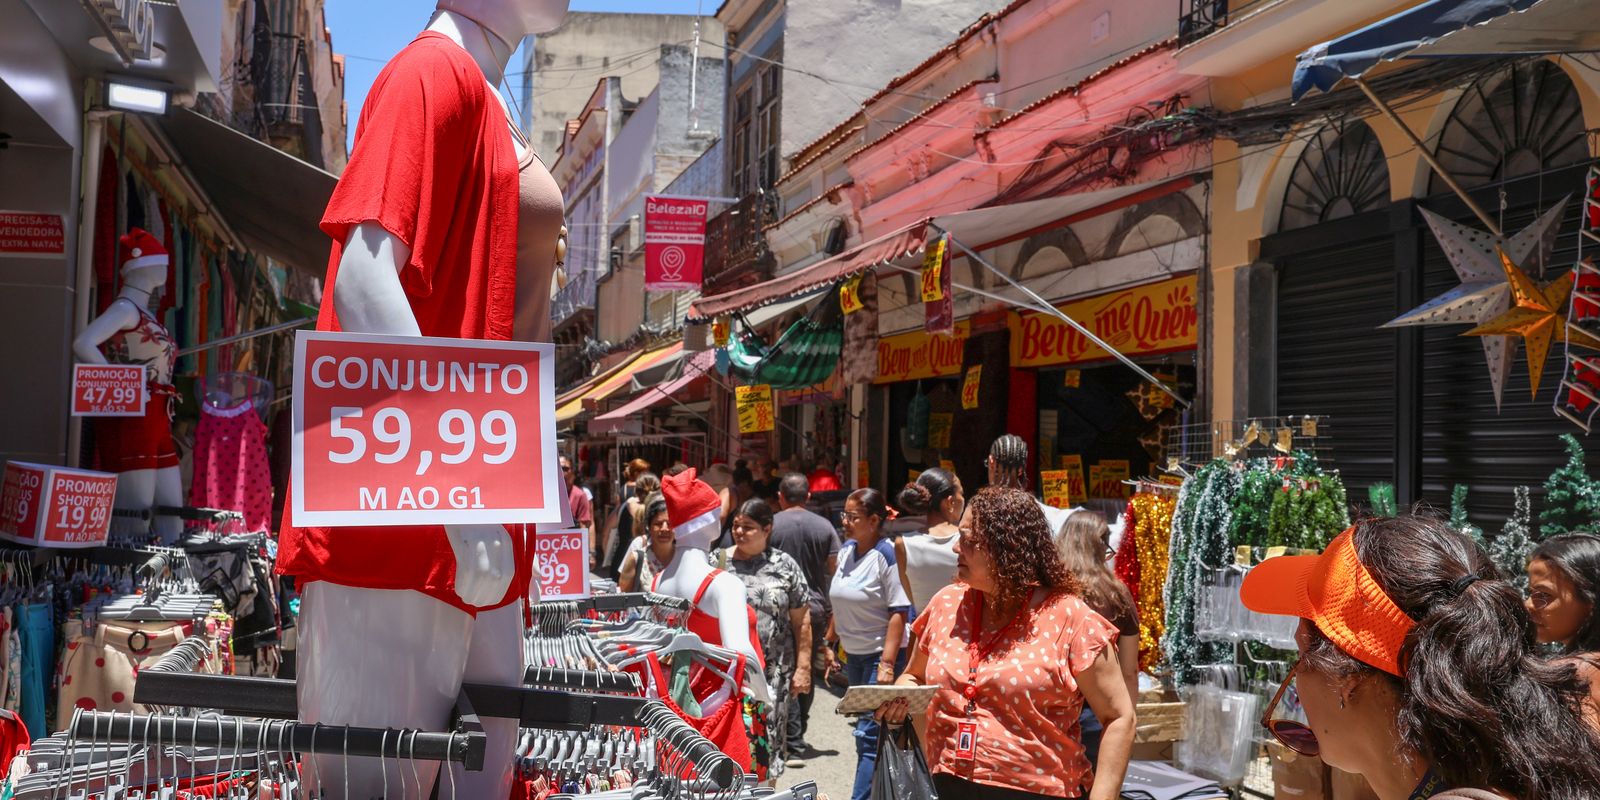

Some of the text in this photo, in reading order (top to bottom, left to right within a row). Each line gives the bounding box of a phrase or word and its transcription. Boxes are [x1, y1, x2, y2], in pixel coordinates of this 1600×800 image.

[0, 227, 62, 237] VENDEDORA
[1020, 315, 1091, 361] Bem
[1095, 299, 1132, 350] me
[878, 342, 912, 379] Bem
[913, 343, 929, 369] me
[76, 380, 141, 389] CONJUNTO PLUS
[79, 369, 138, 381] PROMOÇÃO
[311, 355, 529, 395] CONJUNTO
[82, 387, 136, 406] 47,99
[328, 405, 518, 475] 59,99
[57, 494, 95, 507] SHORT
[359, 486, 486, 510] M AO G1
[56, 506, 107, 533] 19,99
[64, 532, 75, 542] M
[536, 535, 581, 554] OÇÃO
[545, 586, 561, 596] GG
